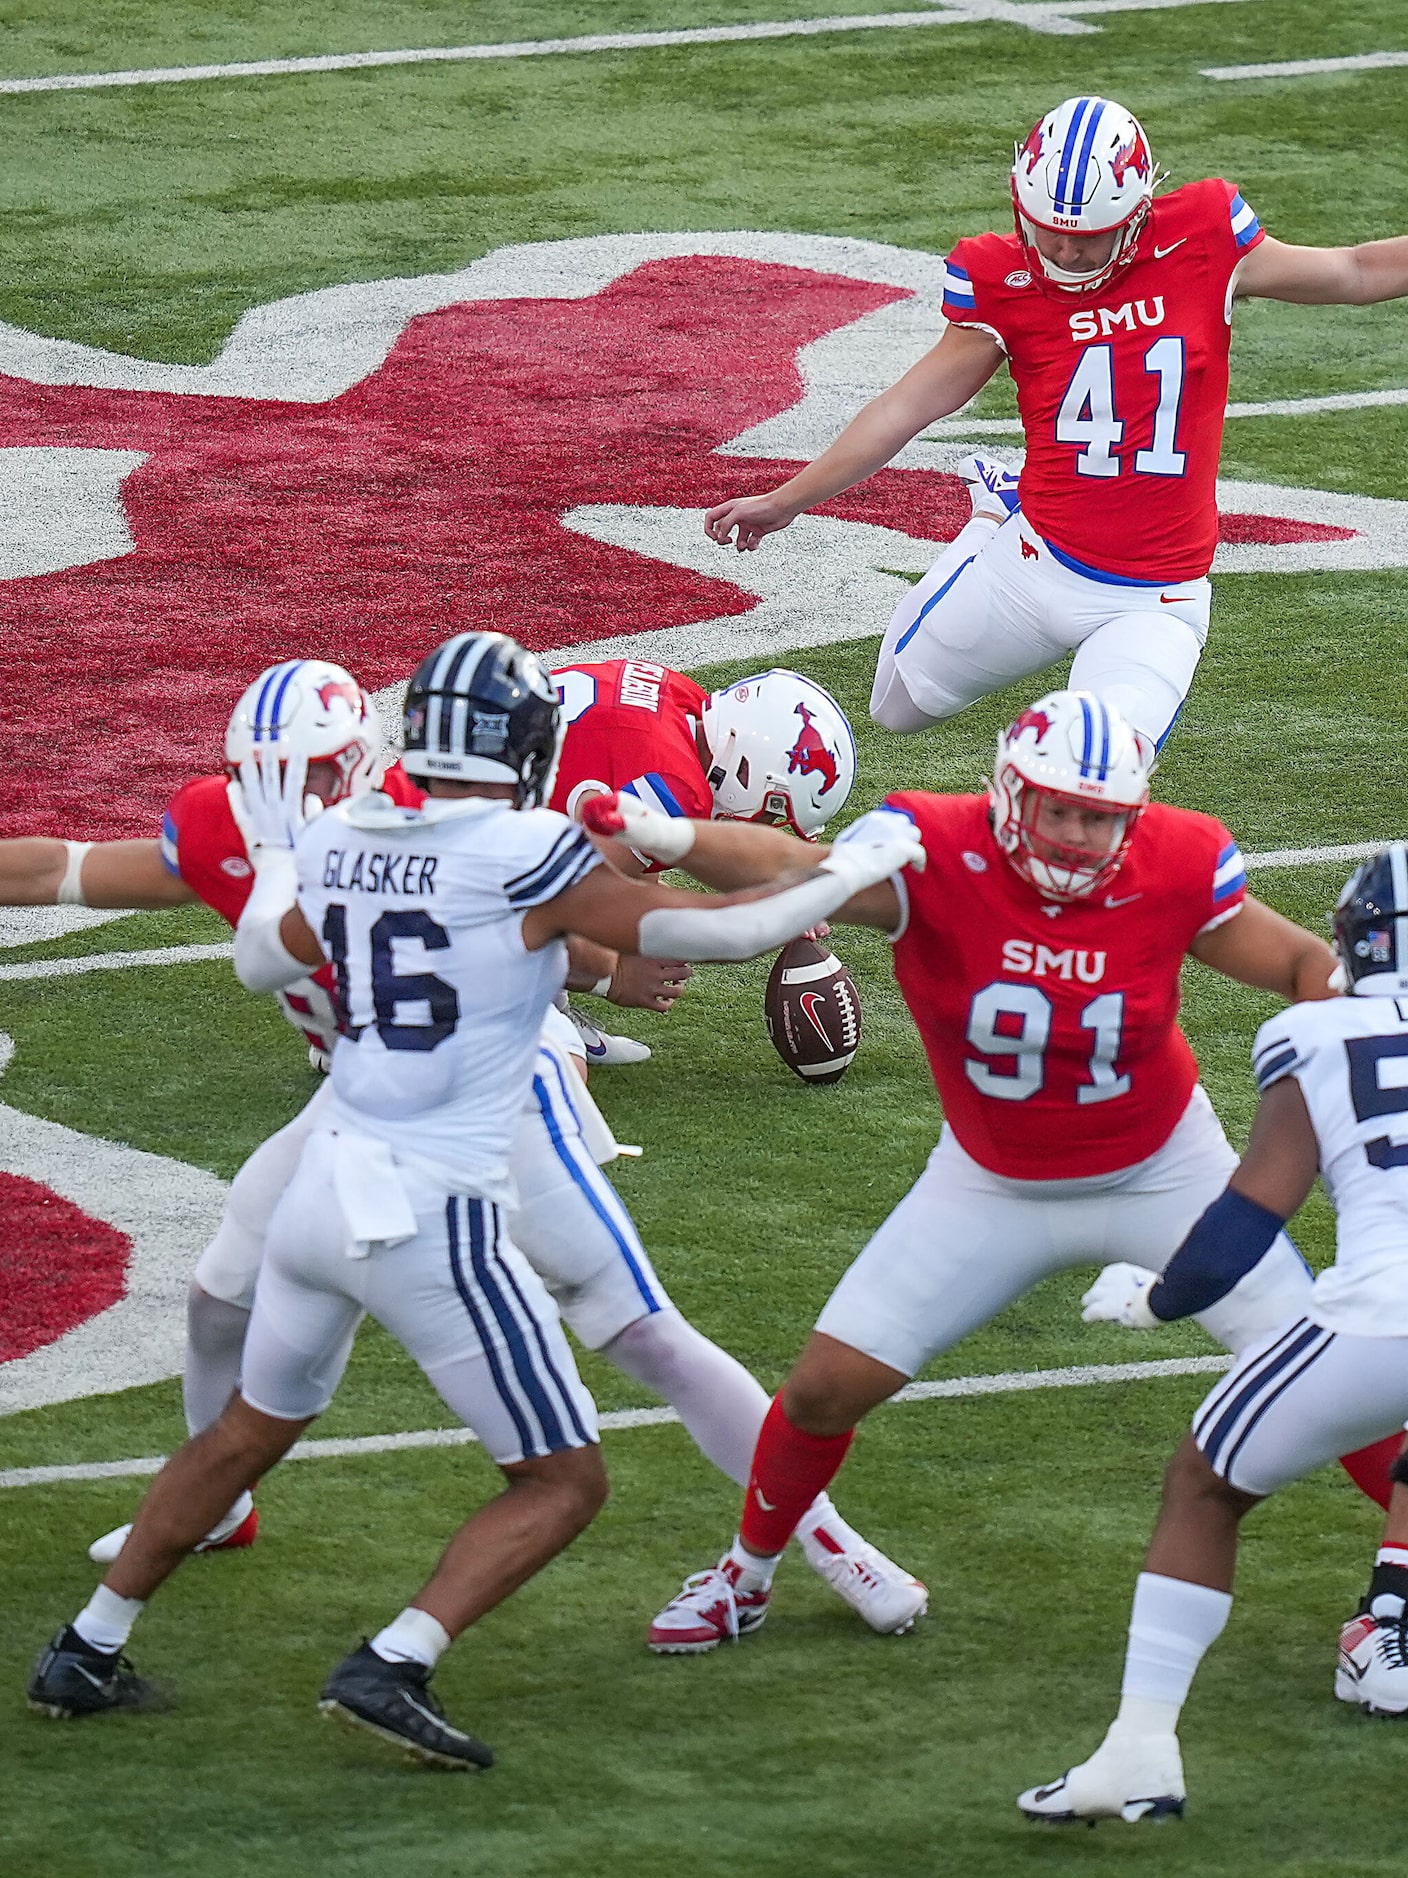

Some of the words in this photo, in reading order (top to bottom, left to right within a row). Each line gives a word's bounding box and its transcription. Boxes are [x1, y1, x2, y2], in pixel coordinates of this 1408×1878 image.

[1053, 216, 1078, 228] SMU
[1068, 296, 1165, 342] SMU
[1055, 336, 1188, 478] 41
[323, 850, 438, 895] GLASKER
[322, 903, 462, 1053] 16
[1001, 938, 1107, 984] SMU
[964, 979, 1132, 1105] 91
